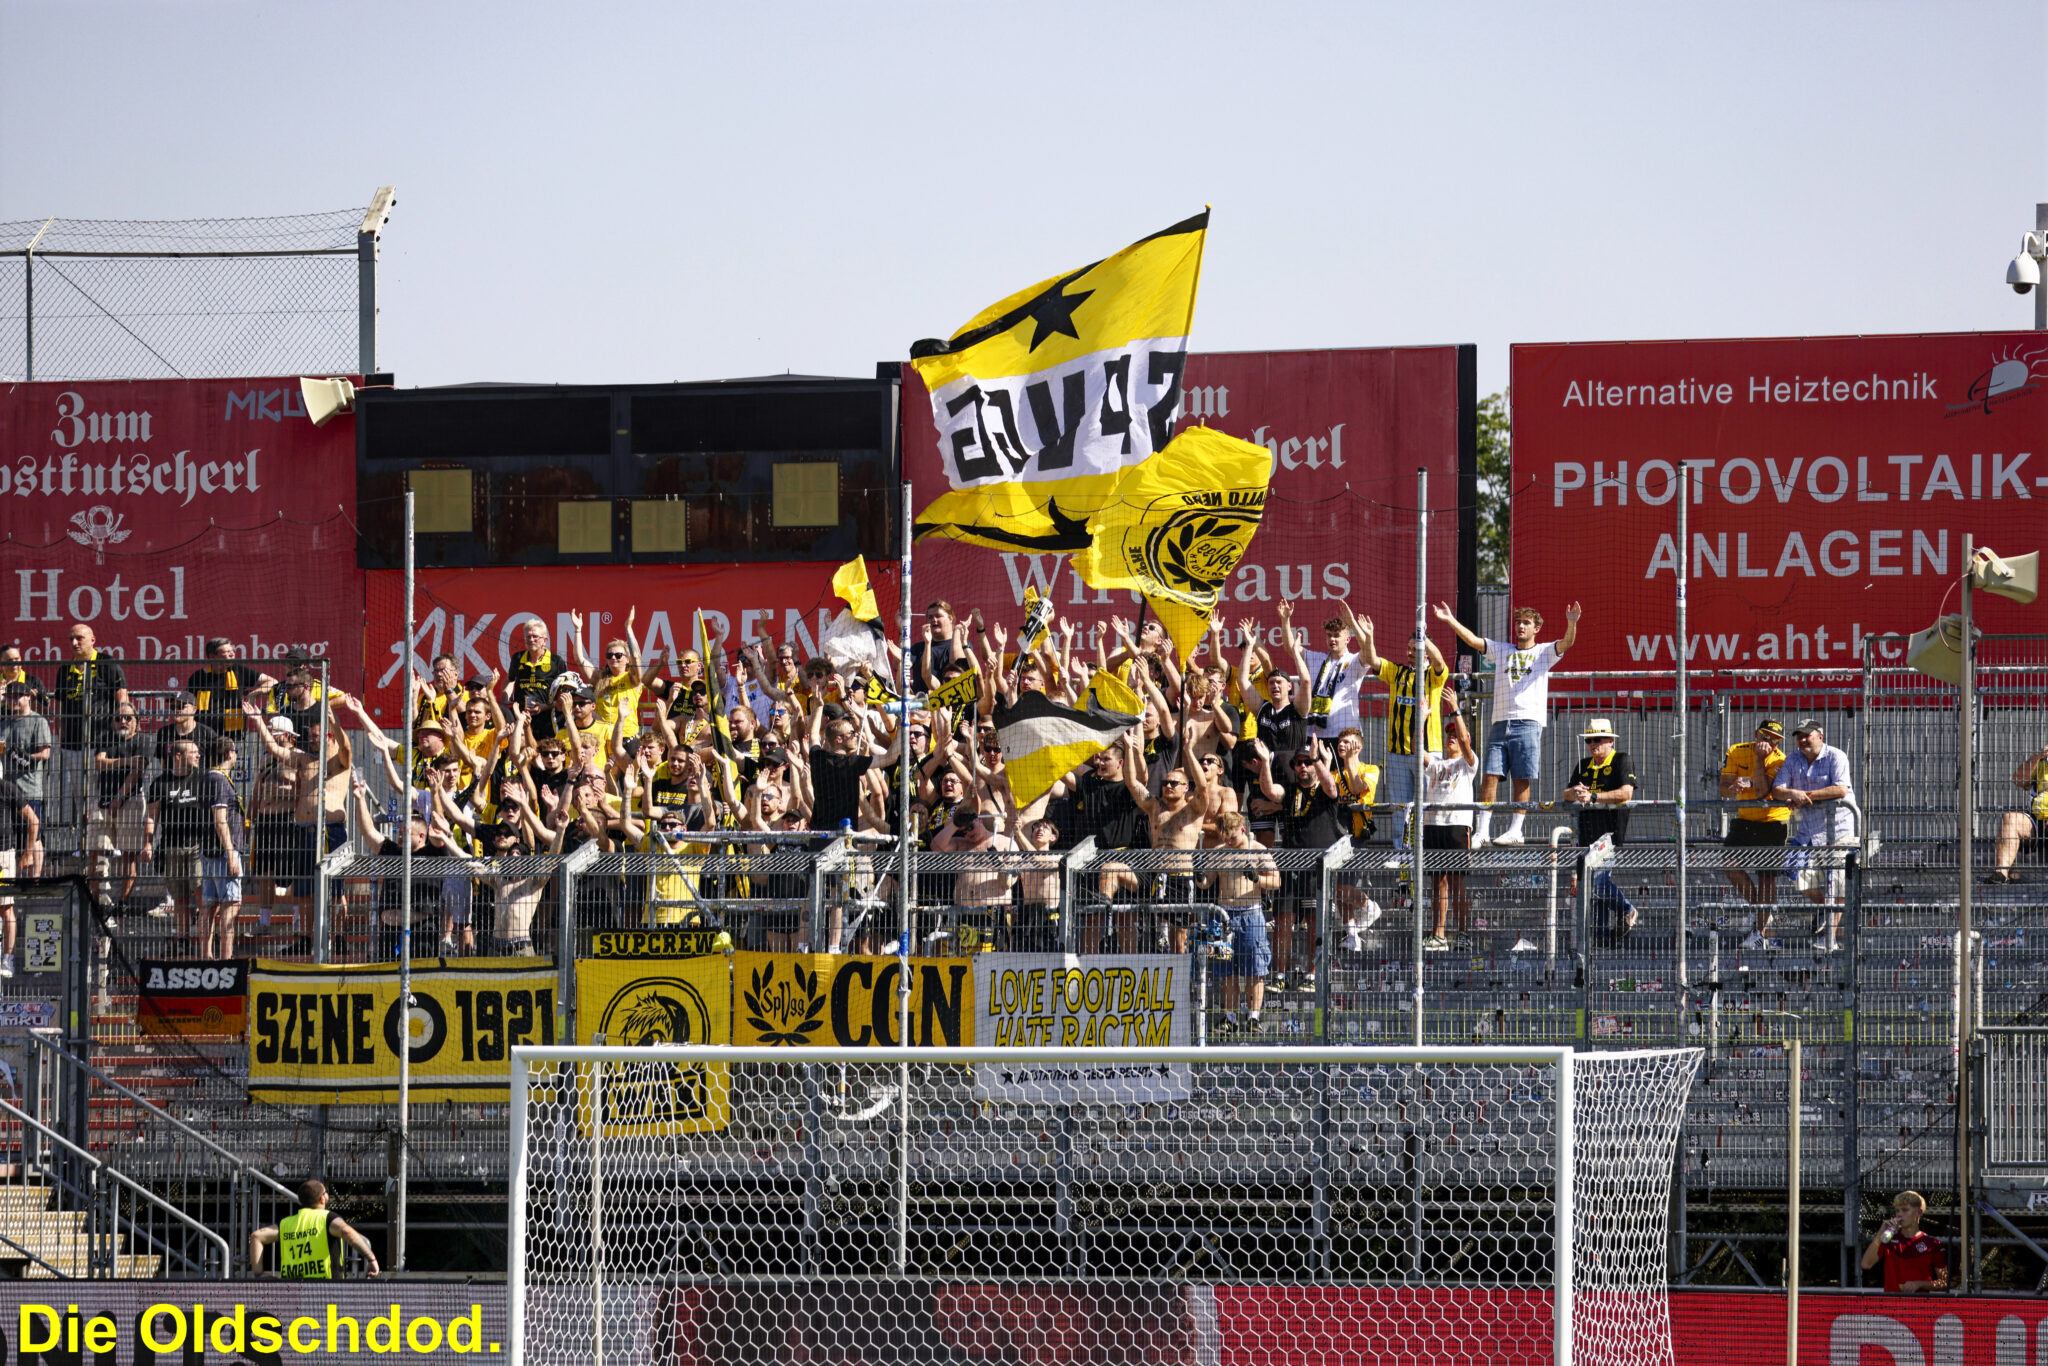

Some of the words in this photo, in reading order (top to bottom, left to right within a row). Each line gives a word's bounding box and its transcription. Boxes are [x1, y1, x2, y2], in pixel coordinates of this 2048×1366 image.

[1563, 378, 1734, 408] Alternative
[1748, 372, 1938, 403] Heiztechnik
[51, 391, 154, 448] Zum
[1645, 529, 1949, 579] ANLAGEN
[14, 566, 189, 622] Hotel
[600, 932, 716, 956] SUPCREW
[146, 967, 238, 990] ASSOS
[989, 968, 1047, 1016] LOVE
[1051, 966, 1175, 1015] FOOTBALL
[760, 981, 806, 1027] SpVgg
[256, 990, 375, 1064] SZENE
[456, 988, 554, 1062] 1921
[995, 1016, 1055, 1047] HATE
[1061, 1011, 1172, 1047] RACISM
[283, 1227, 318, 1240] STEWARD
[289, 1241, 313, 1260] 174
[281, 1259, 325, 1278] EMPIRE
